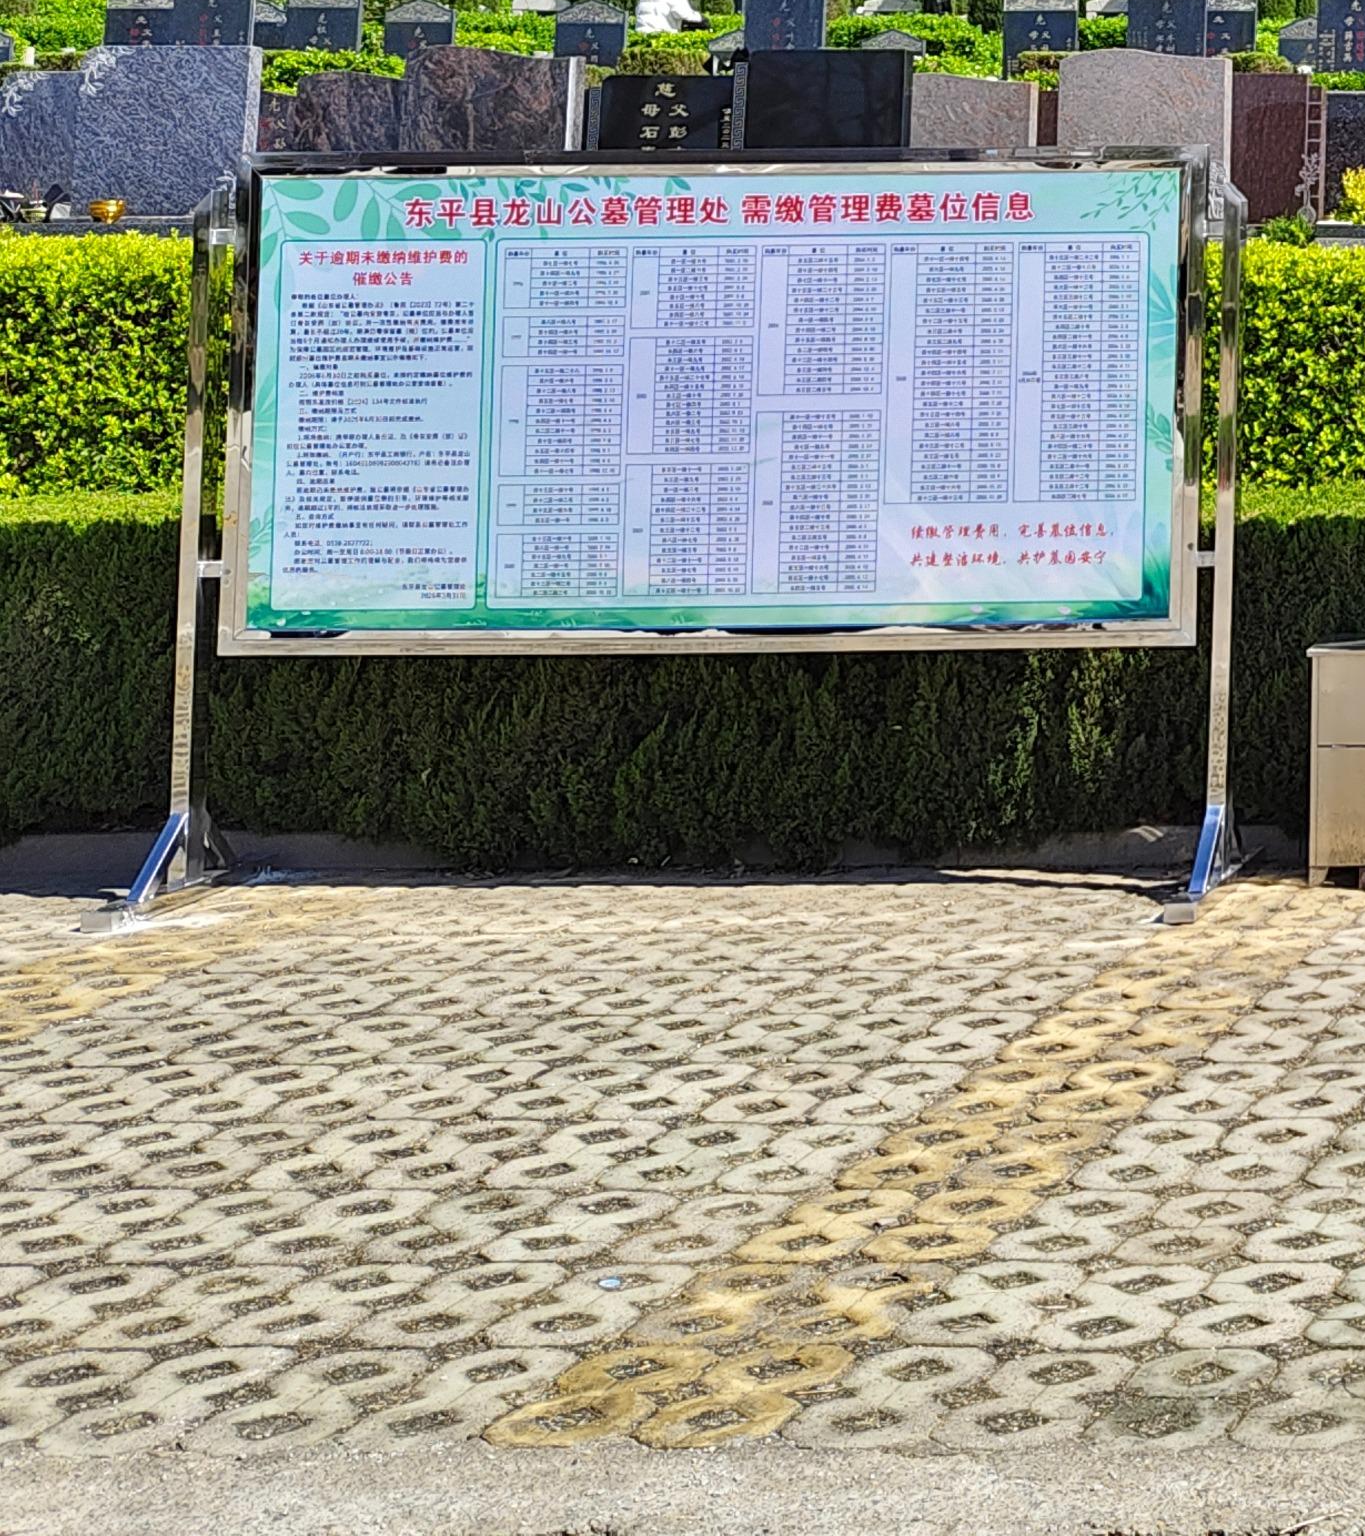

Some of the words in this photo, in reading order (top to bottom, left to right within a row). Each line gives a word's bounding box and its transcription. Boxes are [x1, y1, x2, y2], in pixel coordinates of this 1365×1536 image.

[654, 82, 677, 98] 慈
[405, 195, 730, 229] 东平县龙山公墓管理处
[741, 192, 1035, 224] 需缴管理费墓位信息
[299, 250, 468, 265] 关于逾期未缴纳维护费的
[353, 272, 414, 286] 催缴公告
